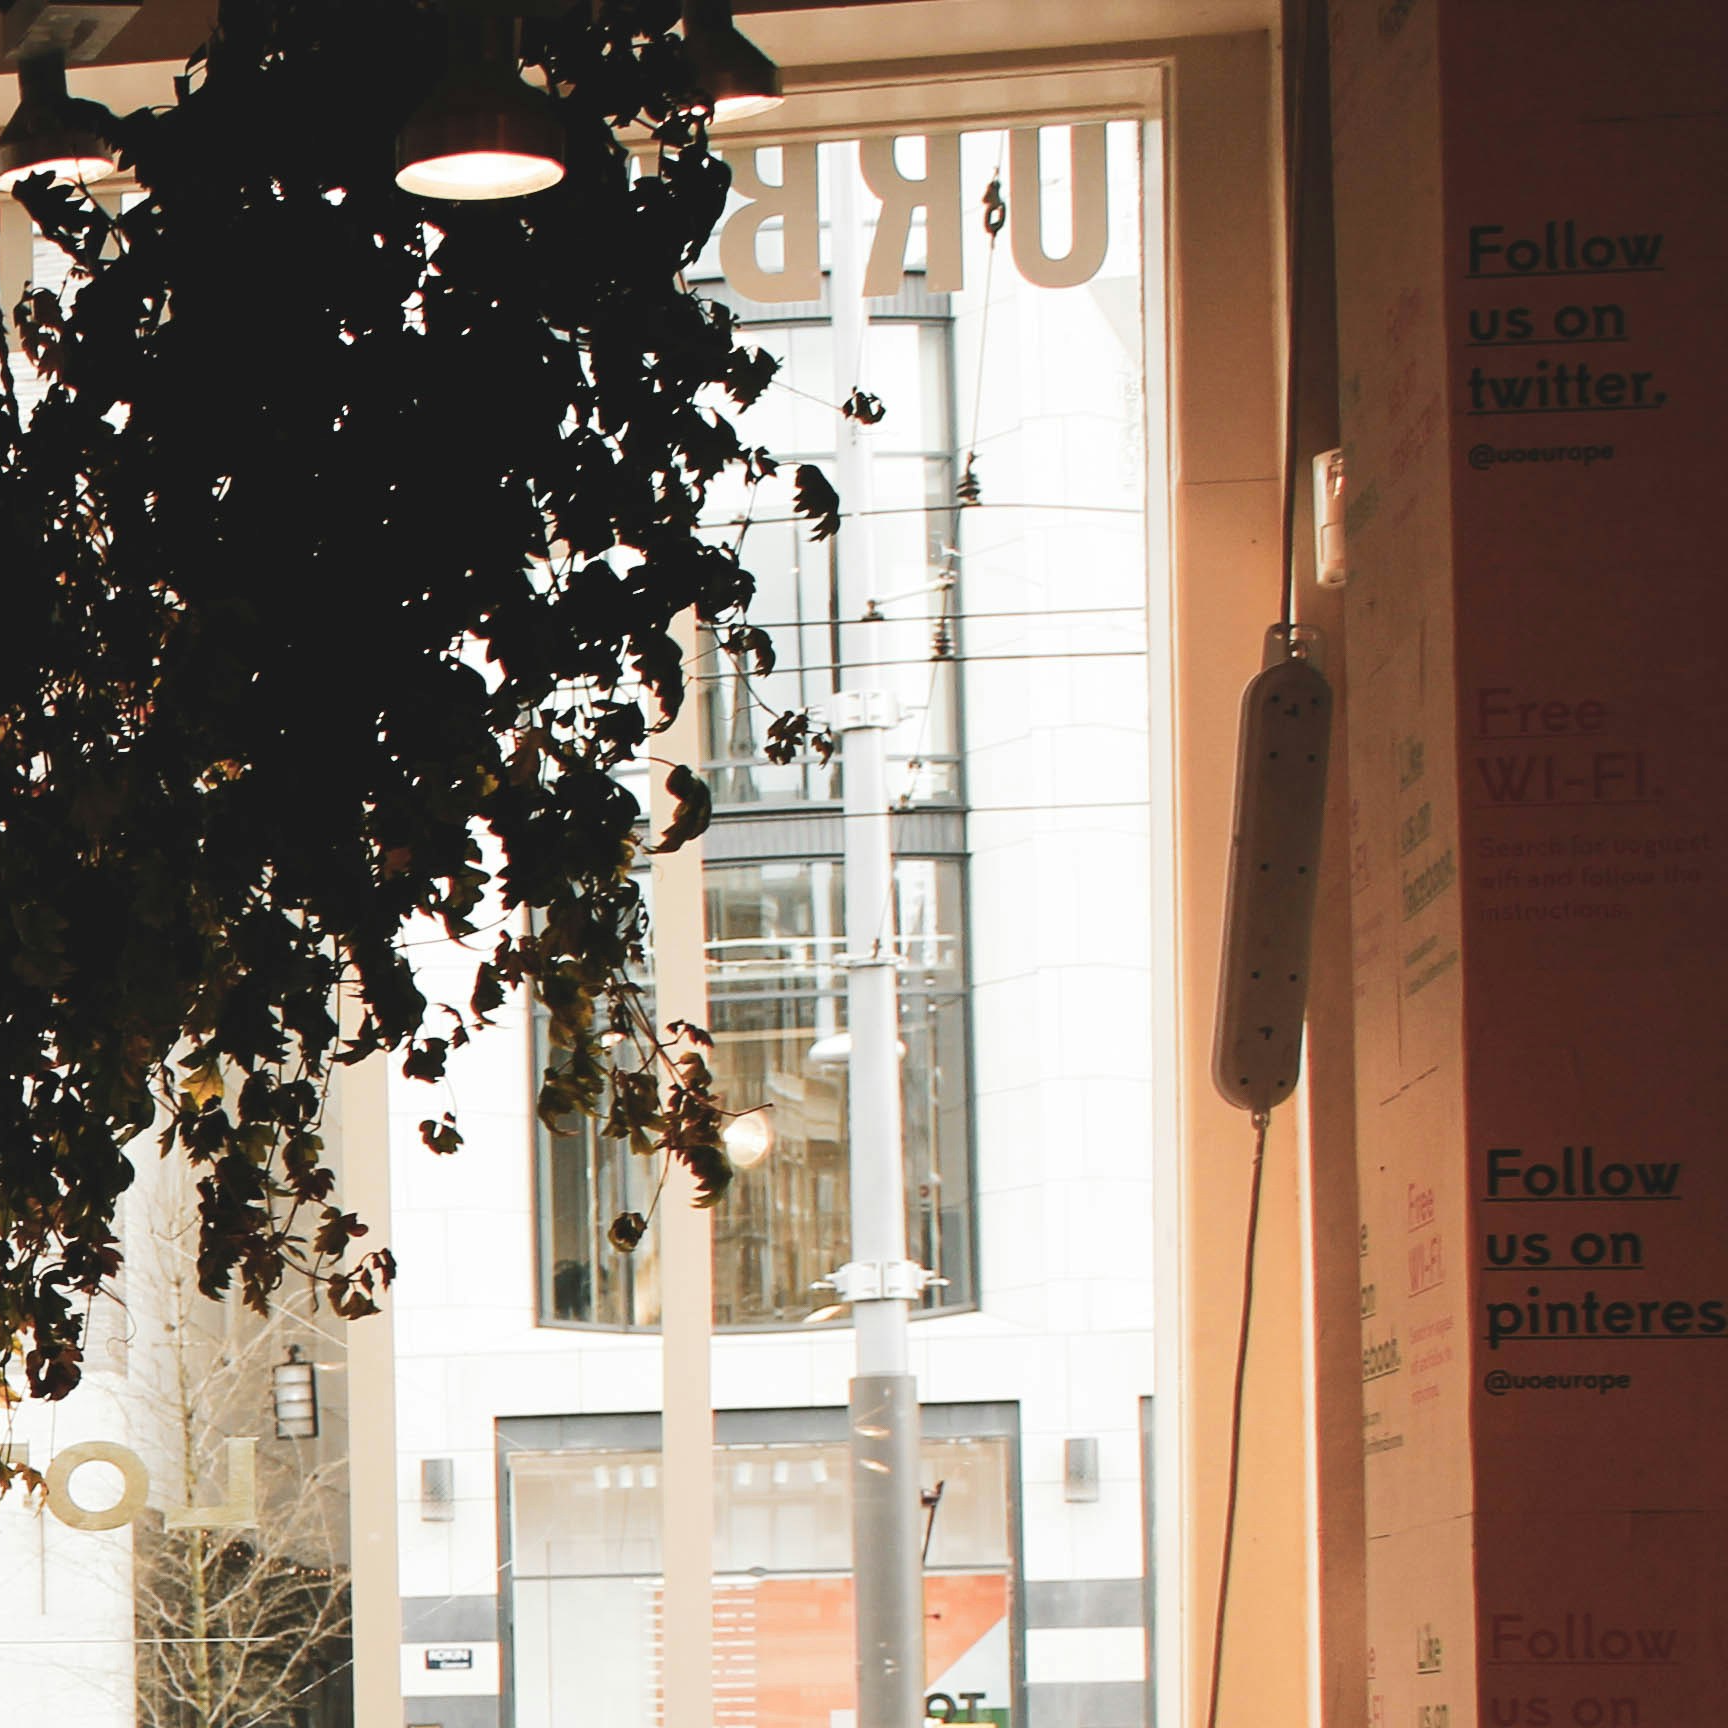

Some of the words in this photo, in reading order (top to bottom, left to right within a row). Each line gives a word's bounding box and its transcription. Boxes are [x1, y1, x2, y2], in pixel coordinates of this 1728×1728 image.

[1468, 219, 1664, 272] Follow
[1468, 306, 1534, 341] us
[1554, 301, 1626, 339] on
[1466, 360, 1668, 409] twitter.
[1476, 689, 1607, 735] Free
[1477, 753, 1665, 803] WI-FI.
[1485, 1148, 1681, 1195] Follow
[1485, 1230, 1551, 1266] us
[1569, 1226, 1643, 1264] on
[1483, 1368, 1631, 1395] @uoeurope
[1492, 1613, 1677, 1659] Follow
[1490, 1696, 1553, 1728] us
[1572, 1695, 1639, 1728] on
